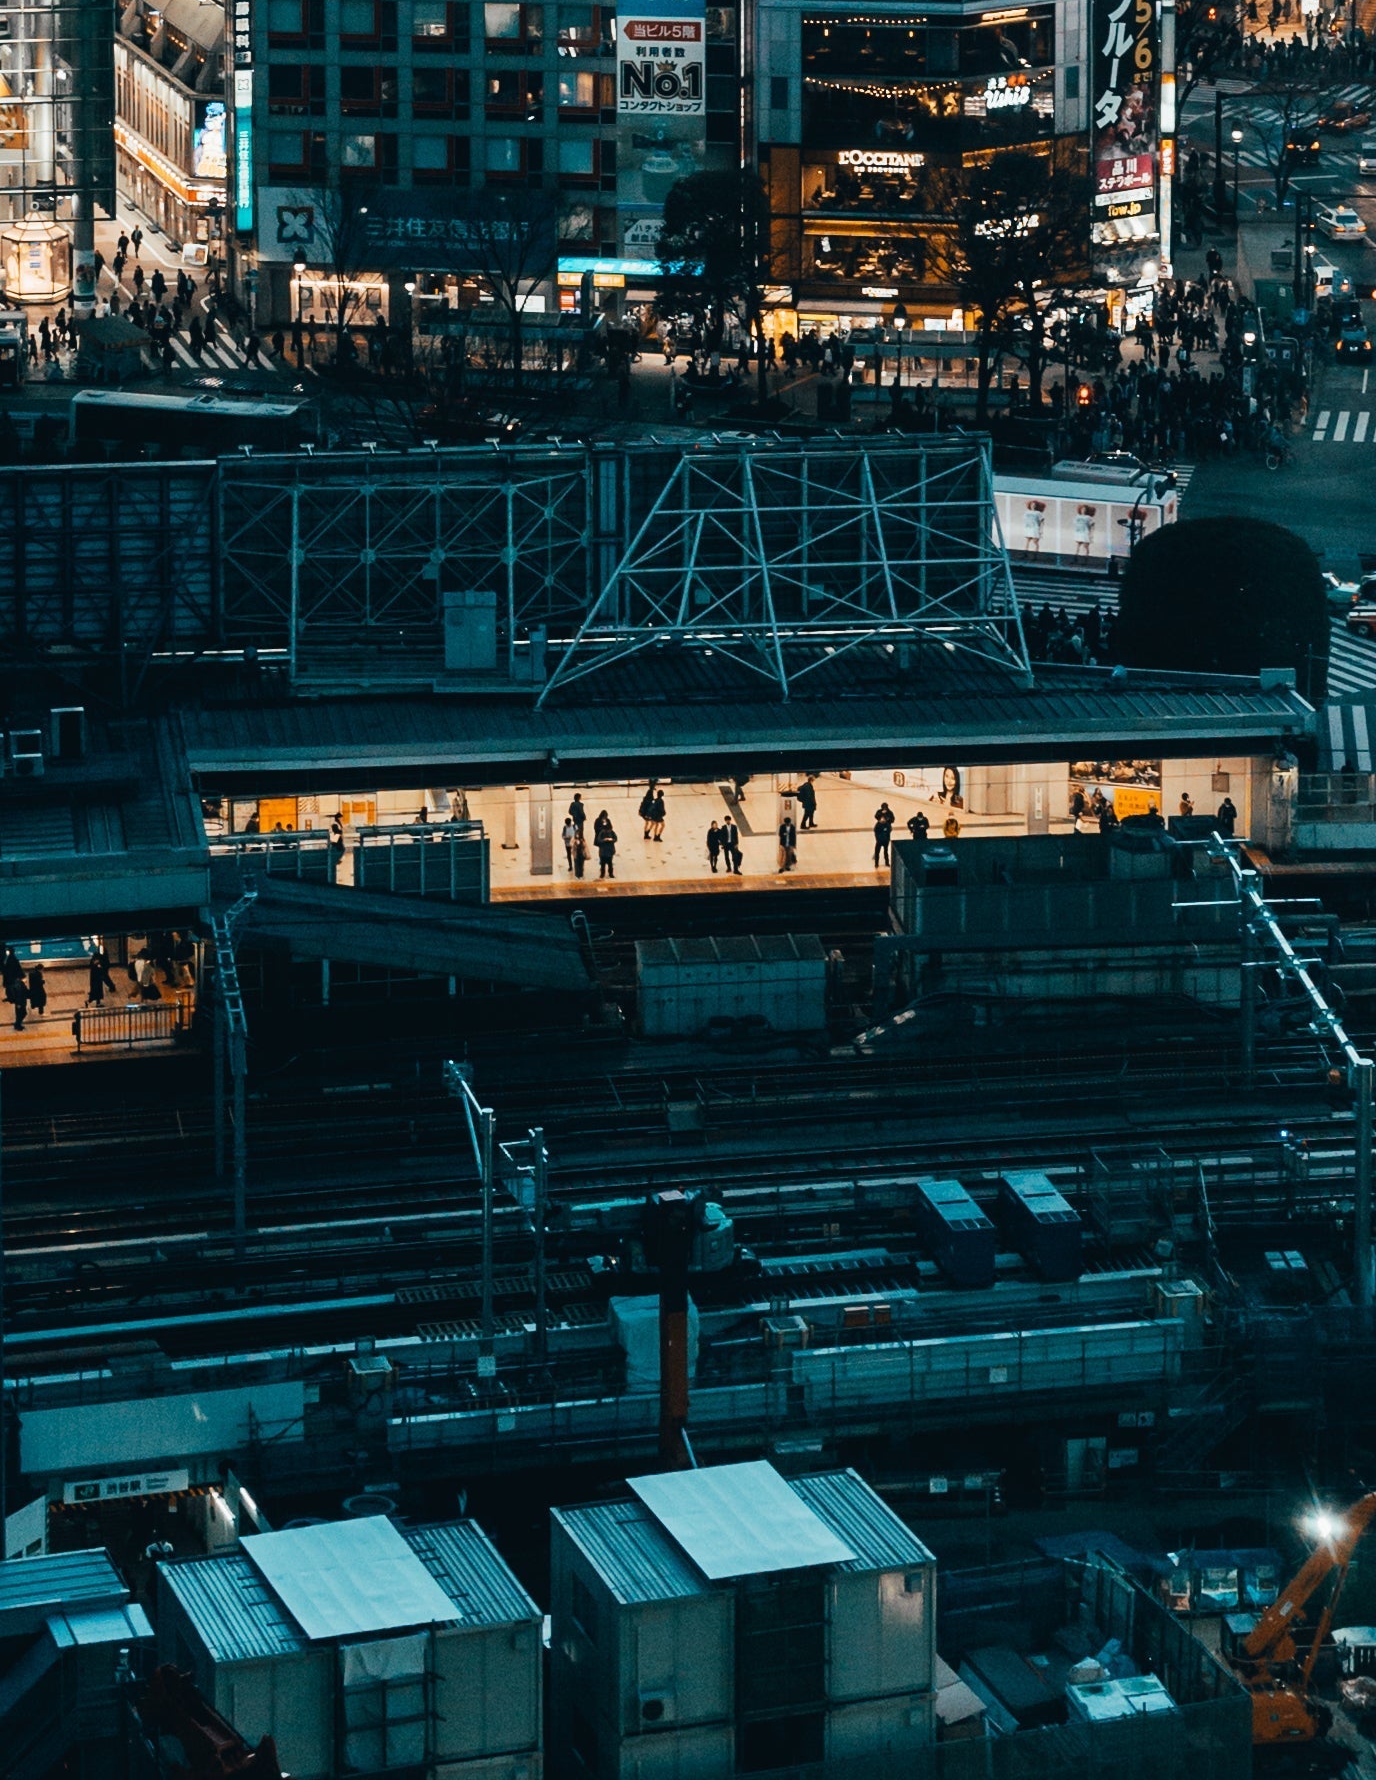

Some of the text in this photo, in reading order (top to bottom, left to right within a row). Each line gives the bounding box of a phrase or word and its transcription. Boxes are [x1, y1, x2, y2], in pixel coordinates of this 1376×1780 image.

[633, 24, 696, 39] 当ビル5階
[635, 46, 686, 59] 利用者数
[619, 60, 703, 101] No.1
[619, 100, 703, 113] コンタクトショップ
[1111, 157, 1138, 175] 品川
